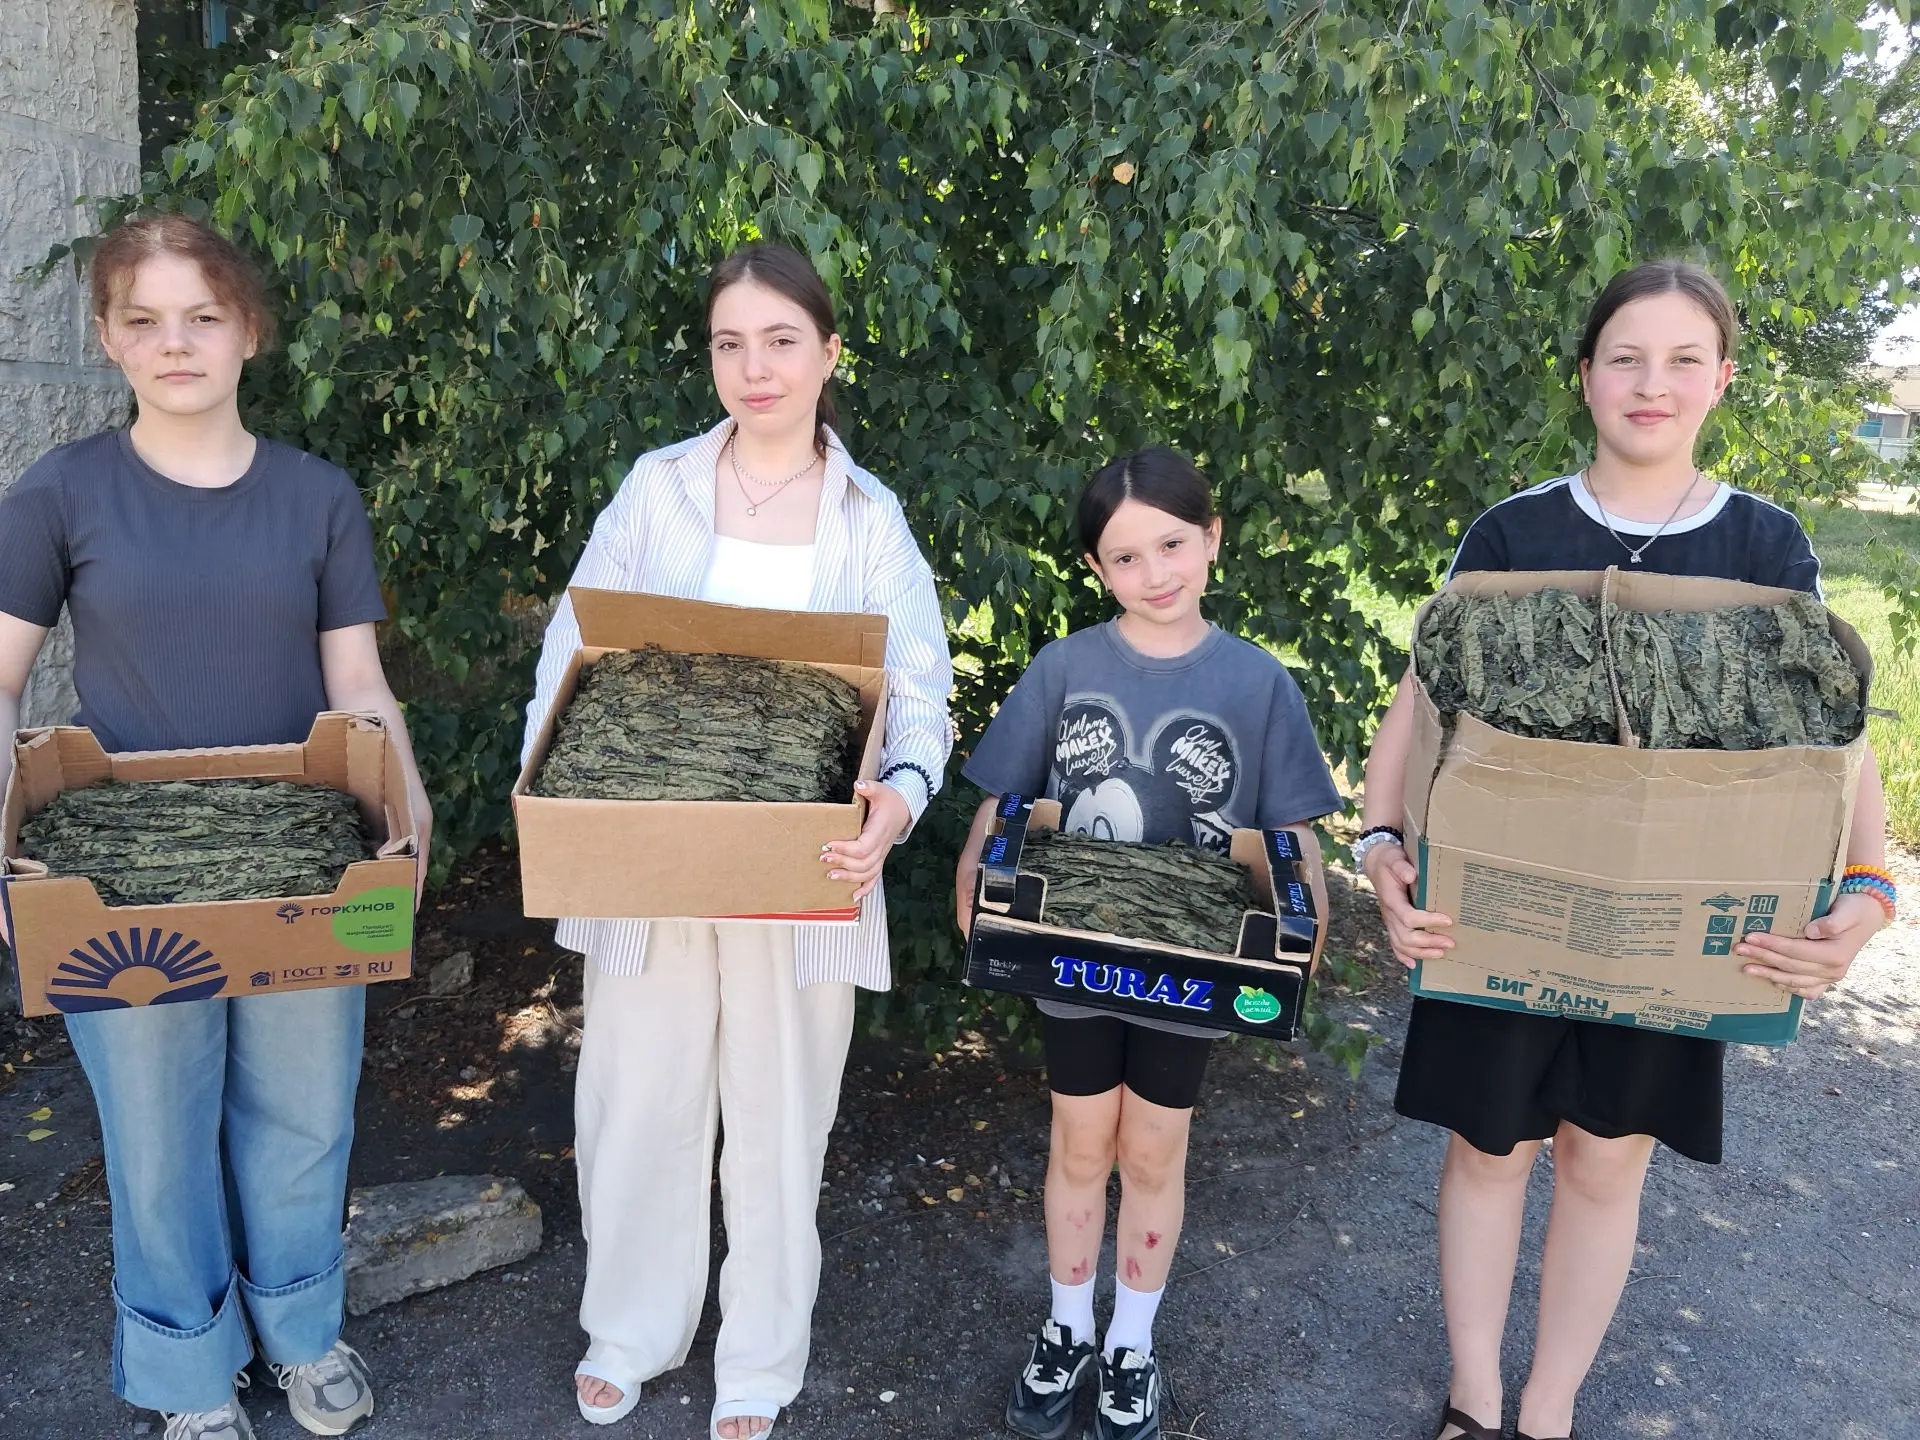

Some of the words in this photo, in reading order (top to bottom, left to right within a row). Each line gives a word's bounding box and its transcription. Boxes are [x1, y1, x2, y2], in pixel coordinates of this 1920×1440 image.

[1056, 726, 1114, 762] MAKEX
[311, 902, 395, 916] ГОРКУНОВ
[283, 966, 327, 979] ГОСТ
[367, 961, 394, 975] RU
[1051, 955, 1215, 1012] TURAZ
[1486, 975, 1533, 997] БИГ
[1538, 987, 1609, 1011] ЛАНЧ
[1532, 1002, 1608, 1018] НАПОЛНЯЕТ
[1648, 1004, 1673, 1014] СОУС
[1674, 1008, 1687, 1016] СО
[1688, 1010, 1708, 1020] 100%
[1638, 1011, 1706, 1029] НАТУРАЛЬНЫМ
